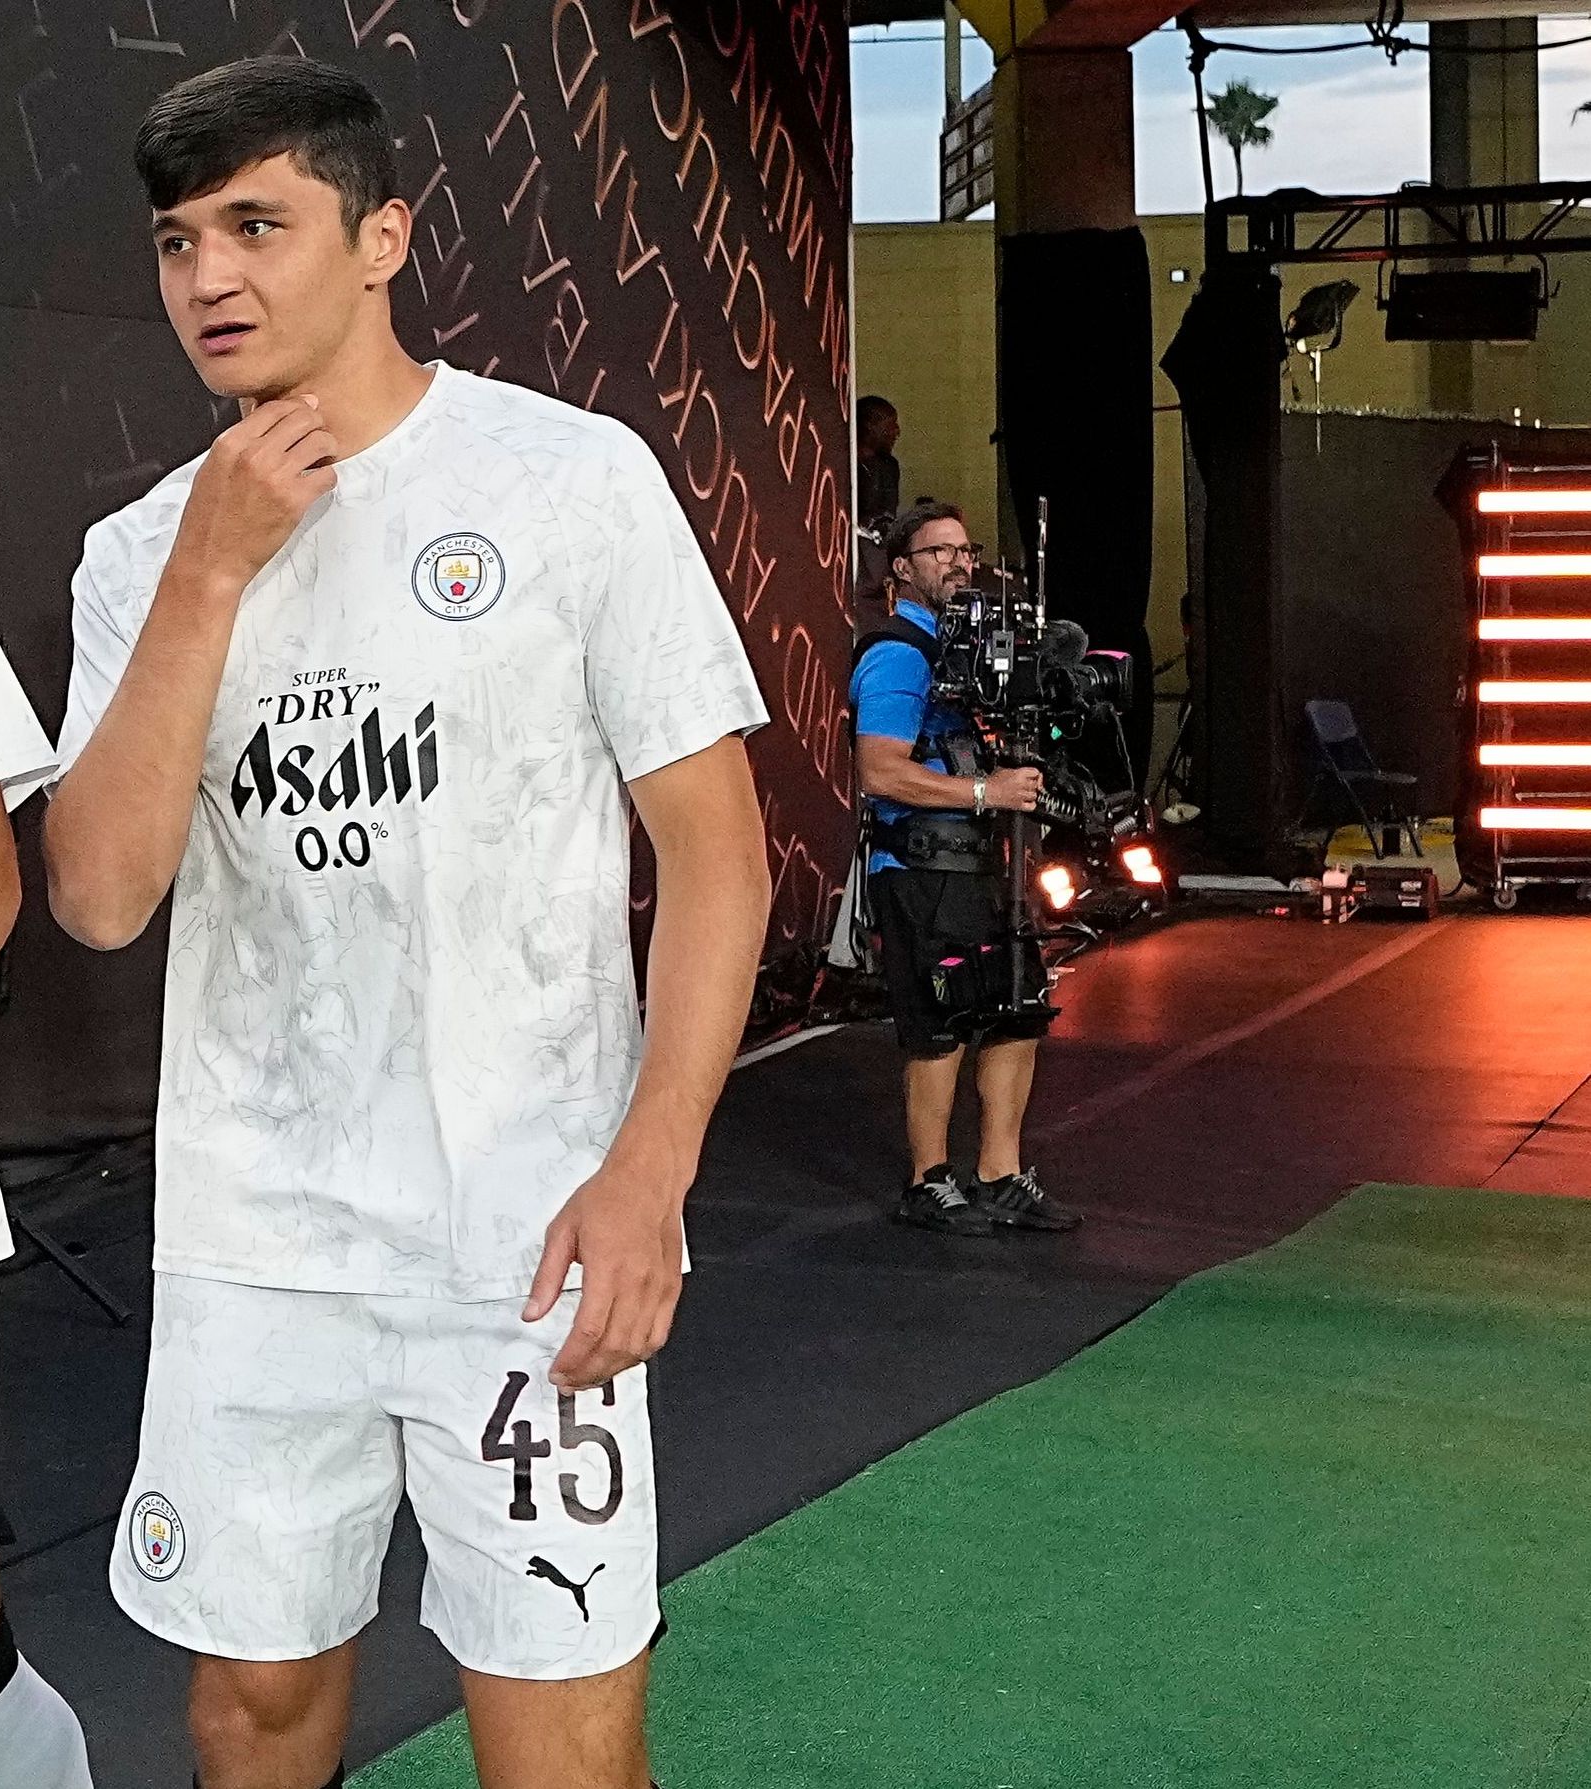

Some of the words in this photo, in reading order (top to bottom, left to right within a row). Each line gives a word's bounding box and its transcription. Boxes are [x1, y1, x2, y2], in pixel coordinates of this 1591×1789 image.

[552, 0, 777, 622] AUCKLAND
[423, 539, 495, 566] MANCHESTER
[444, 605, 471, 614] CITY
[292, 667, 347, 687] SUPER
[230, 700, 440, 820] Asahi
[480, 1370, 624, 1526] 45
